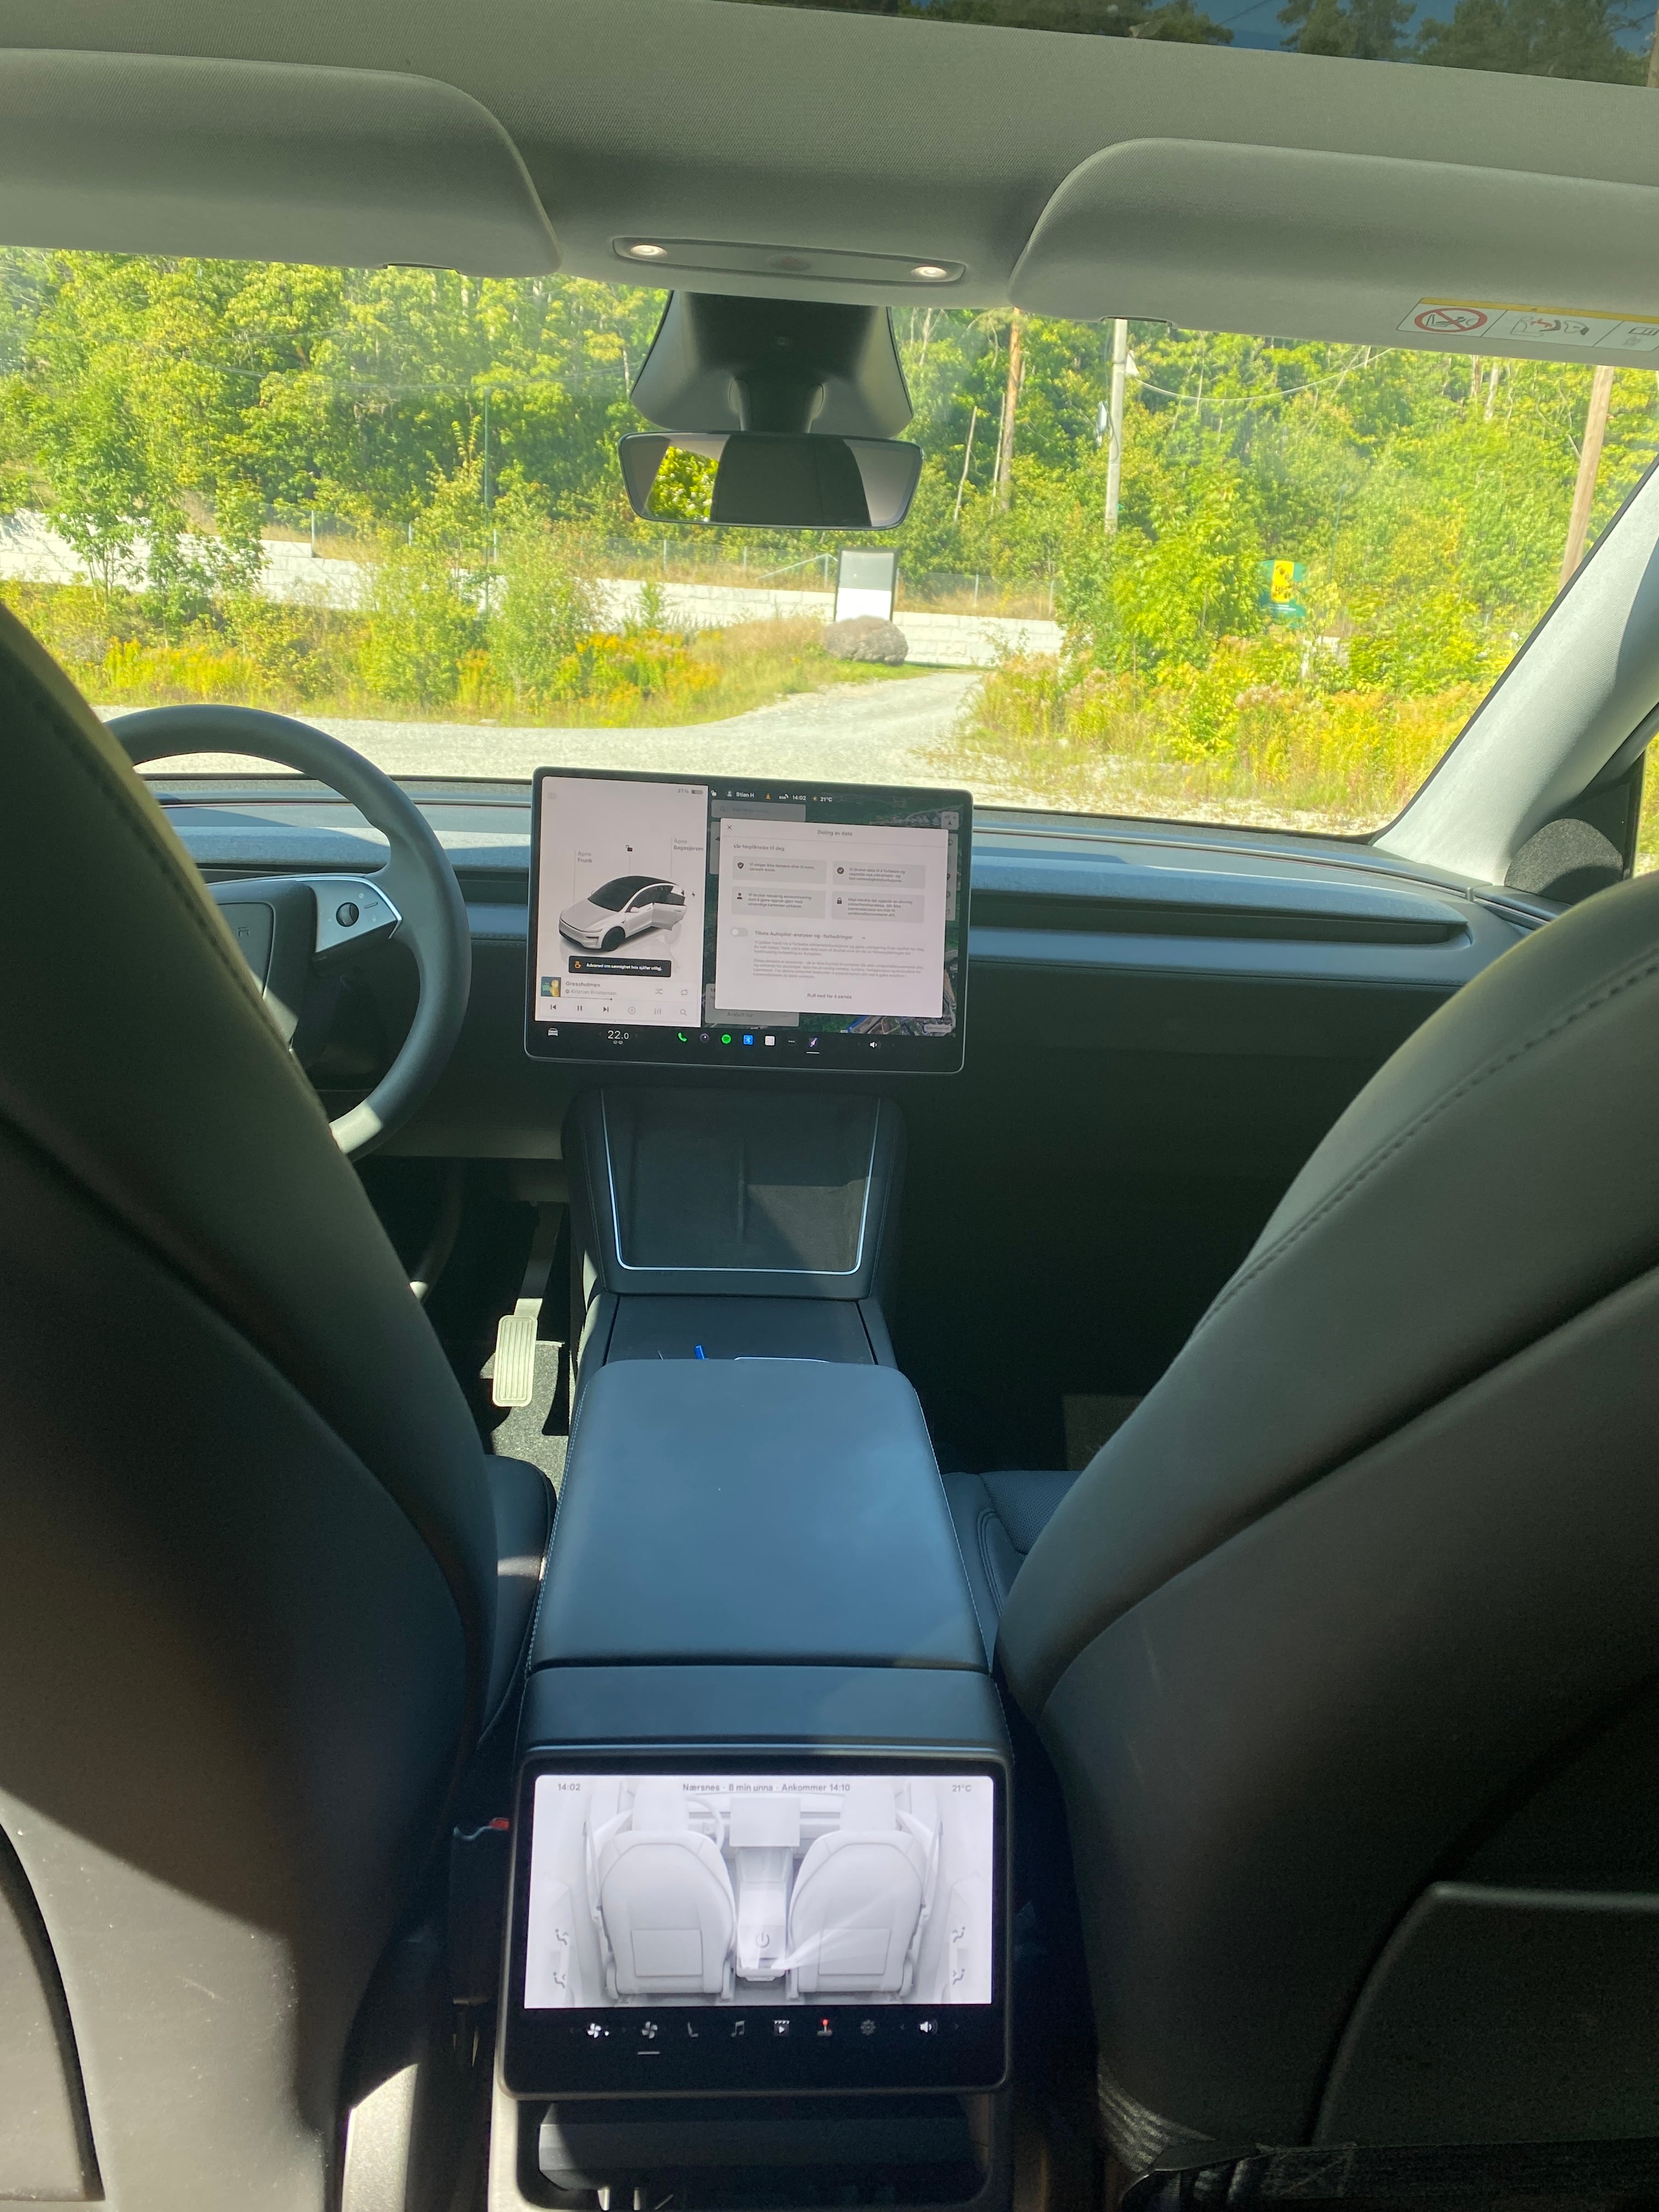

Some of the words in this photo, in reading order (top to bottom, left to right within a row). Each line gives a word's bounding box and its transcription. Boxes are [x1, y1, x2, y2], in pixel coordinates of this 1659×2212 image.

[607, 1030, 630, 1040] 22.0
[557, 1783, 581, 1791] 14:02
[682, 1784, 720, 1792] Nærsnes
[729, 1784, 734, 1792] 8
[736, 1784, 752, 1792] min
[782, 1784, 826, 1792] Ankommer
[952, 1784, 972, 1792] 21°C
